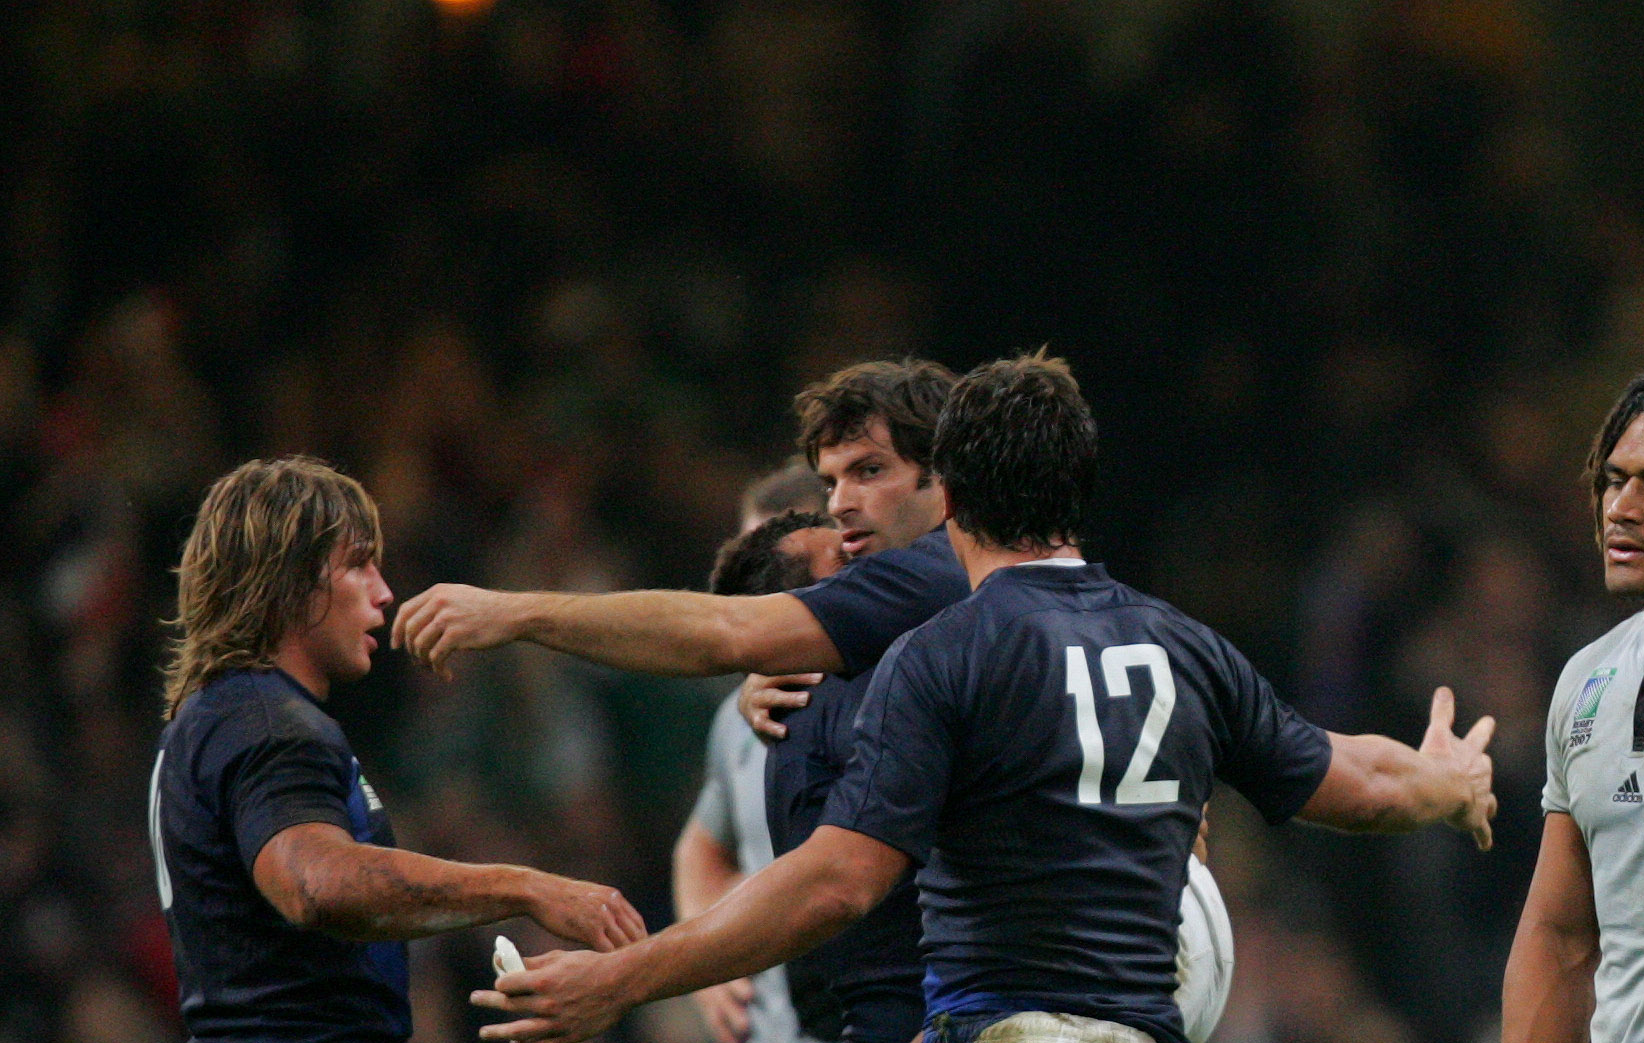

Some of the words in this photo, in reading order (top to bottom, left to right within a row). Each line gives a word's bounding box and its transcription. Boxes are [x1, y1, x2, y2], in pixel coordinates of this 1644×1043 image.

[1065, 643, 1180, 804] 12
[1569, 733, 1592, 748] 2007
[1612, 791, 1644, 803] adidas
